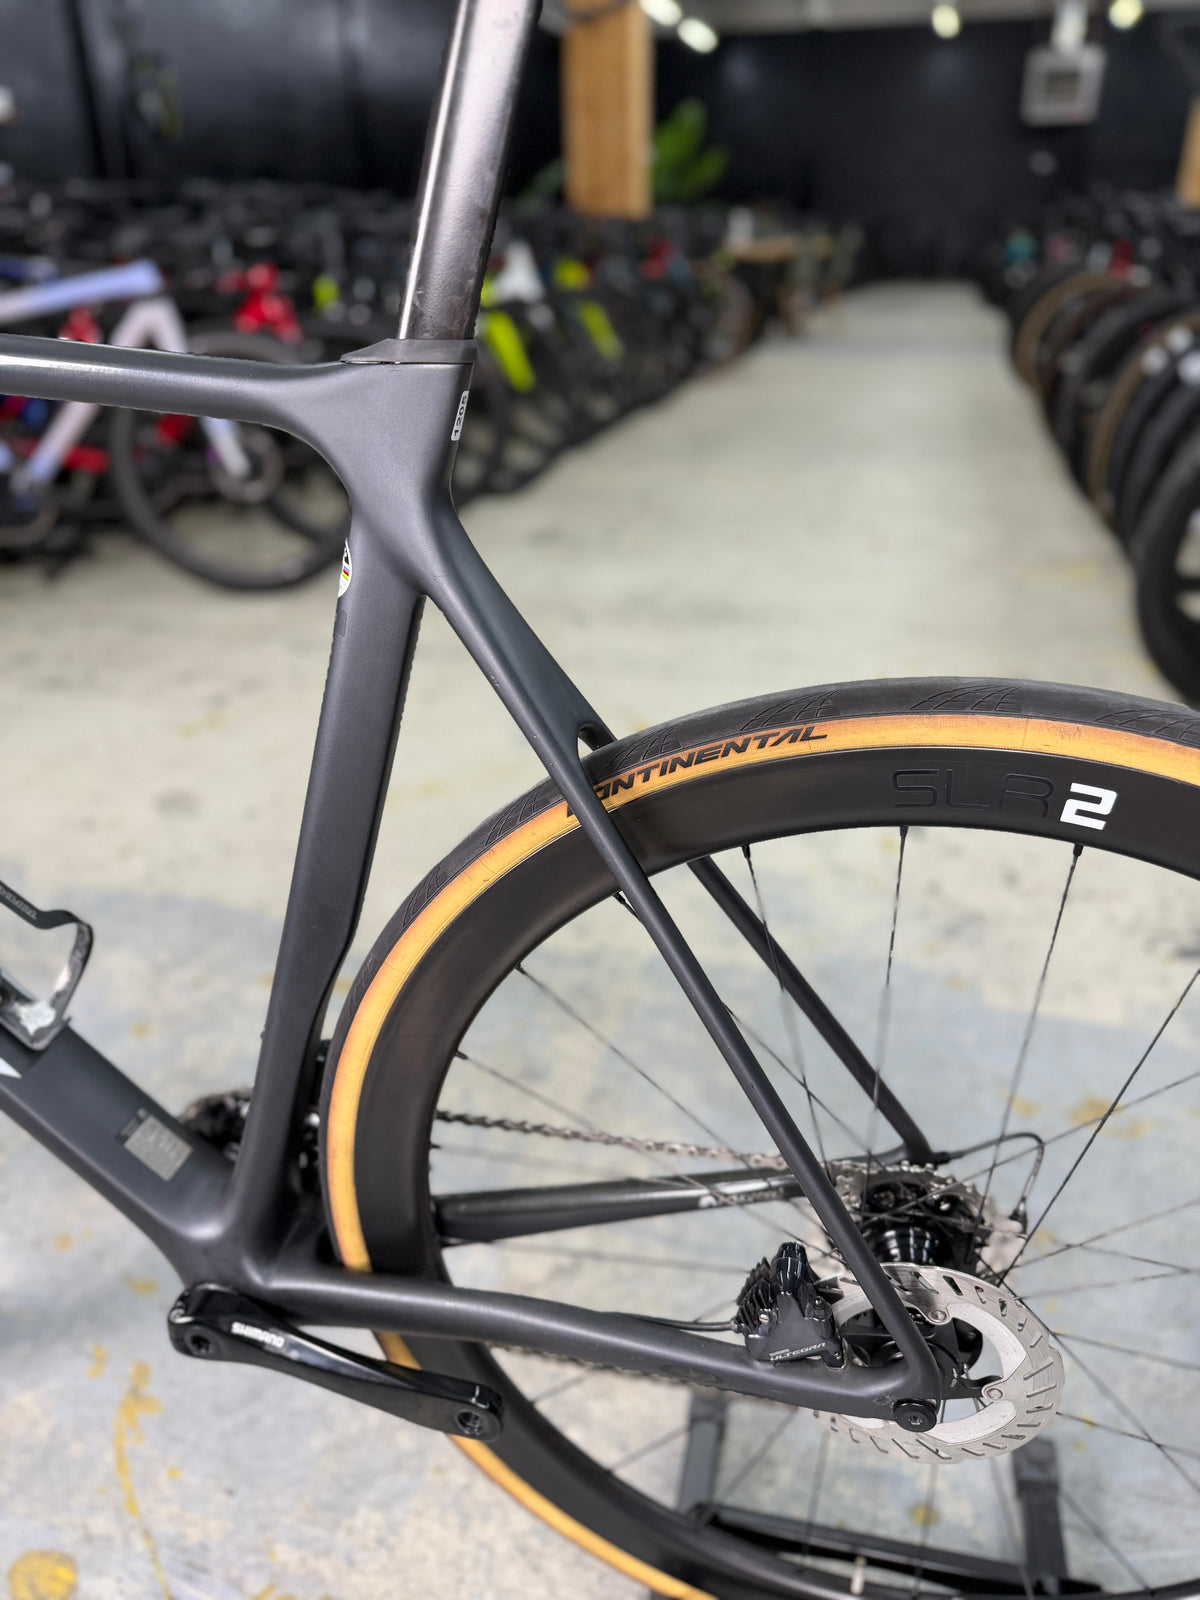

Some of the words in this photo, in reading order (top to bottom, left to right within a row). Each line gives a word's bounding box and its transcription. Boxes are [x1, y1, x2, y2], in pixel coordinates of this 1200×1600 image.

[567, 726, 827, 817] ONTINENTAL
[230, 1321, 285, 1348] SHIMANO
[770, 1341, 826, 1361] ULTEGRA
